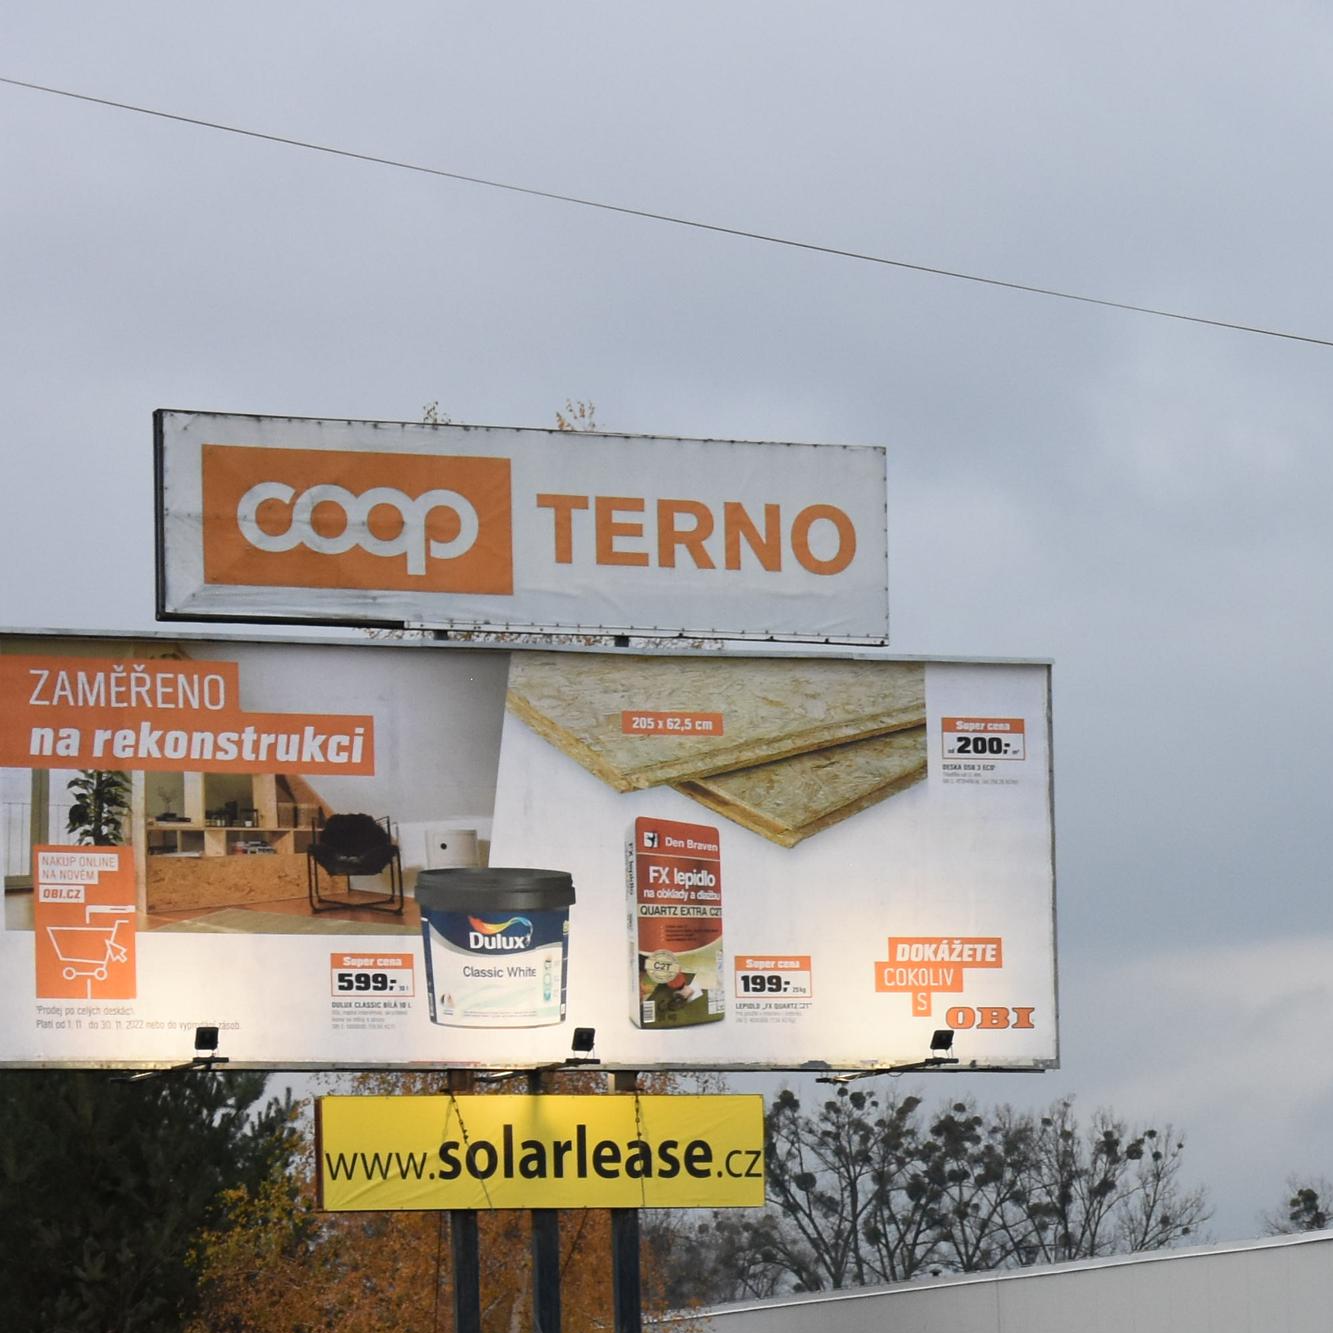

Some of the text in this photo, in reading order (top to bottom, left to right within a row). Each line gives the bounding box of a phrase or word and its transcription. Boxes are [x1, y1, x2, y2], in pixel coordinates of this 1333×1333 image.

[237, 481, 856, 576] coop TERNO
[28, 664, 226, 710] ZAMĚŘENO
[632, 717, 654, 729] 205
[666, 718, 692, 732] 62,5
[695, 720, 713, 730] cm
[29, 721, 365, 764] na rekonstrukci
[665, 836, 718, 852] Den Braven
[79, 856, 116, 868] ONLINE
[42, 870, 56, 880] NA
[649, 866, 716, 890] FX lepidlo
[42, 889, 81, 899] OBI.CZ
[640, 905, 679, 916] QUARTZ
[680, 906, 708, 917] EXTRA
[469, 932, 527, 950] Dulux
[896, 939, 997, 962] DOKÁŽETE
[463, 965, 537, 978] Classic White
[884, 967, 954, 987] COKOLIV
[916, 992, 928, 1011] S
[945, 1006, 1036, 1030] OBI
[324, 1124, 763, 1181] www.solarlease.cz
